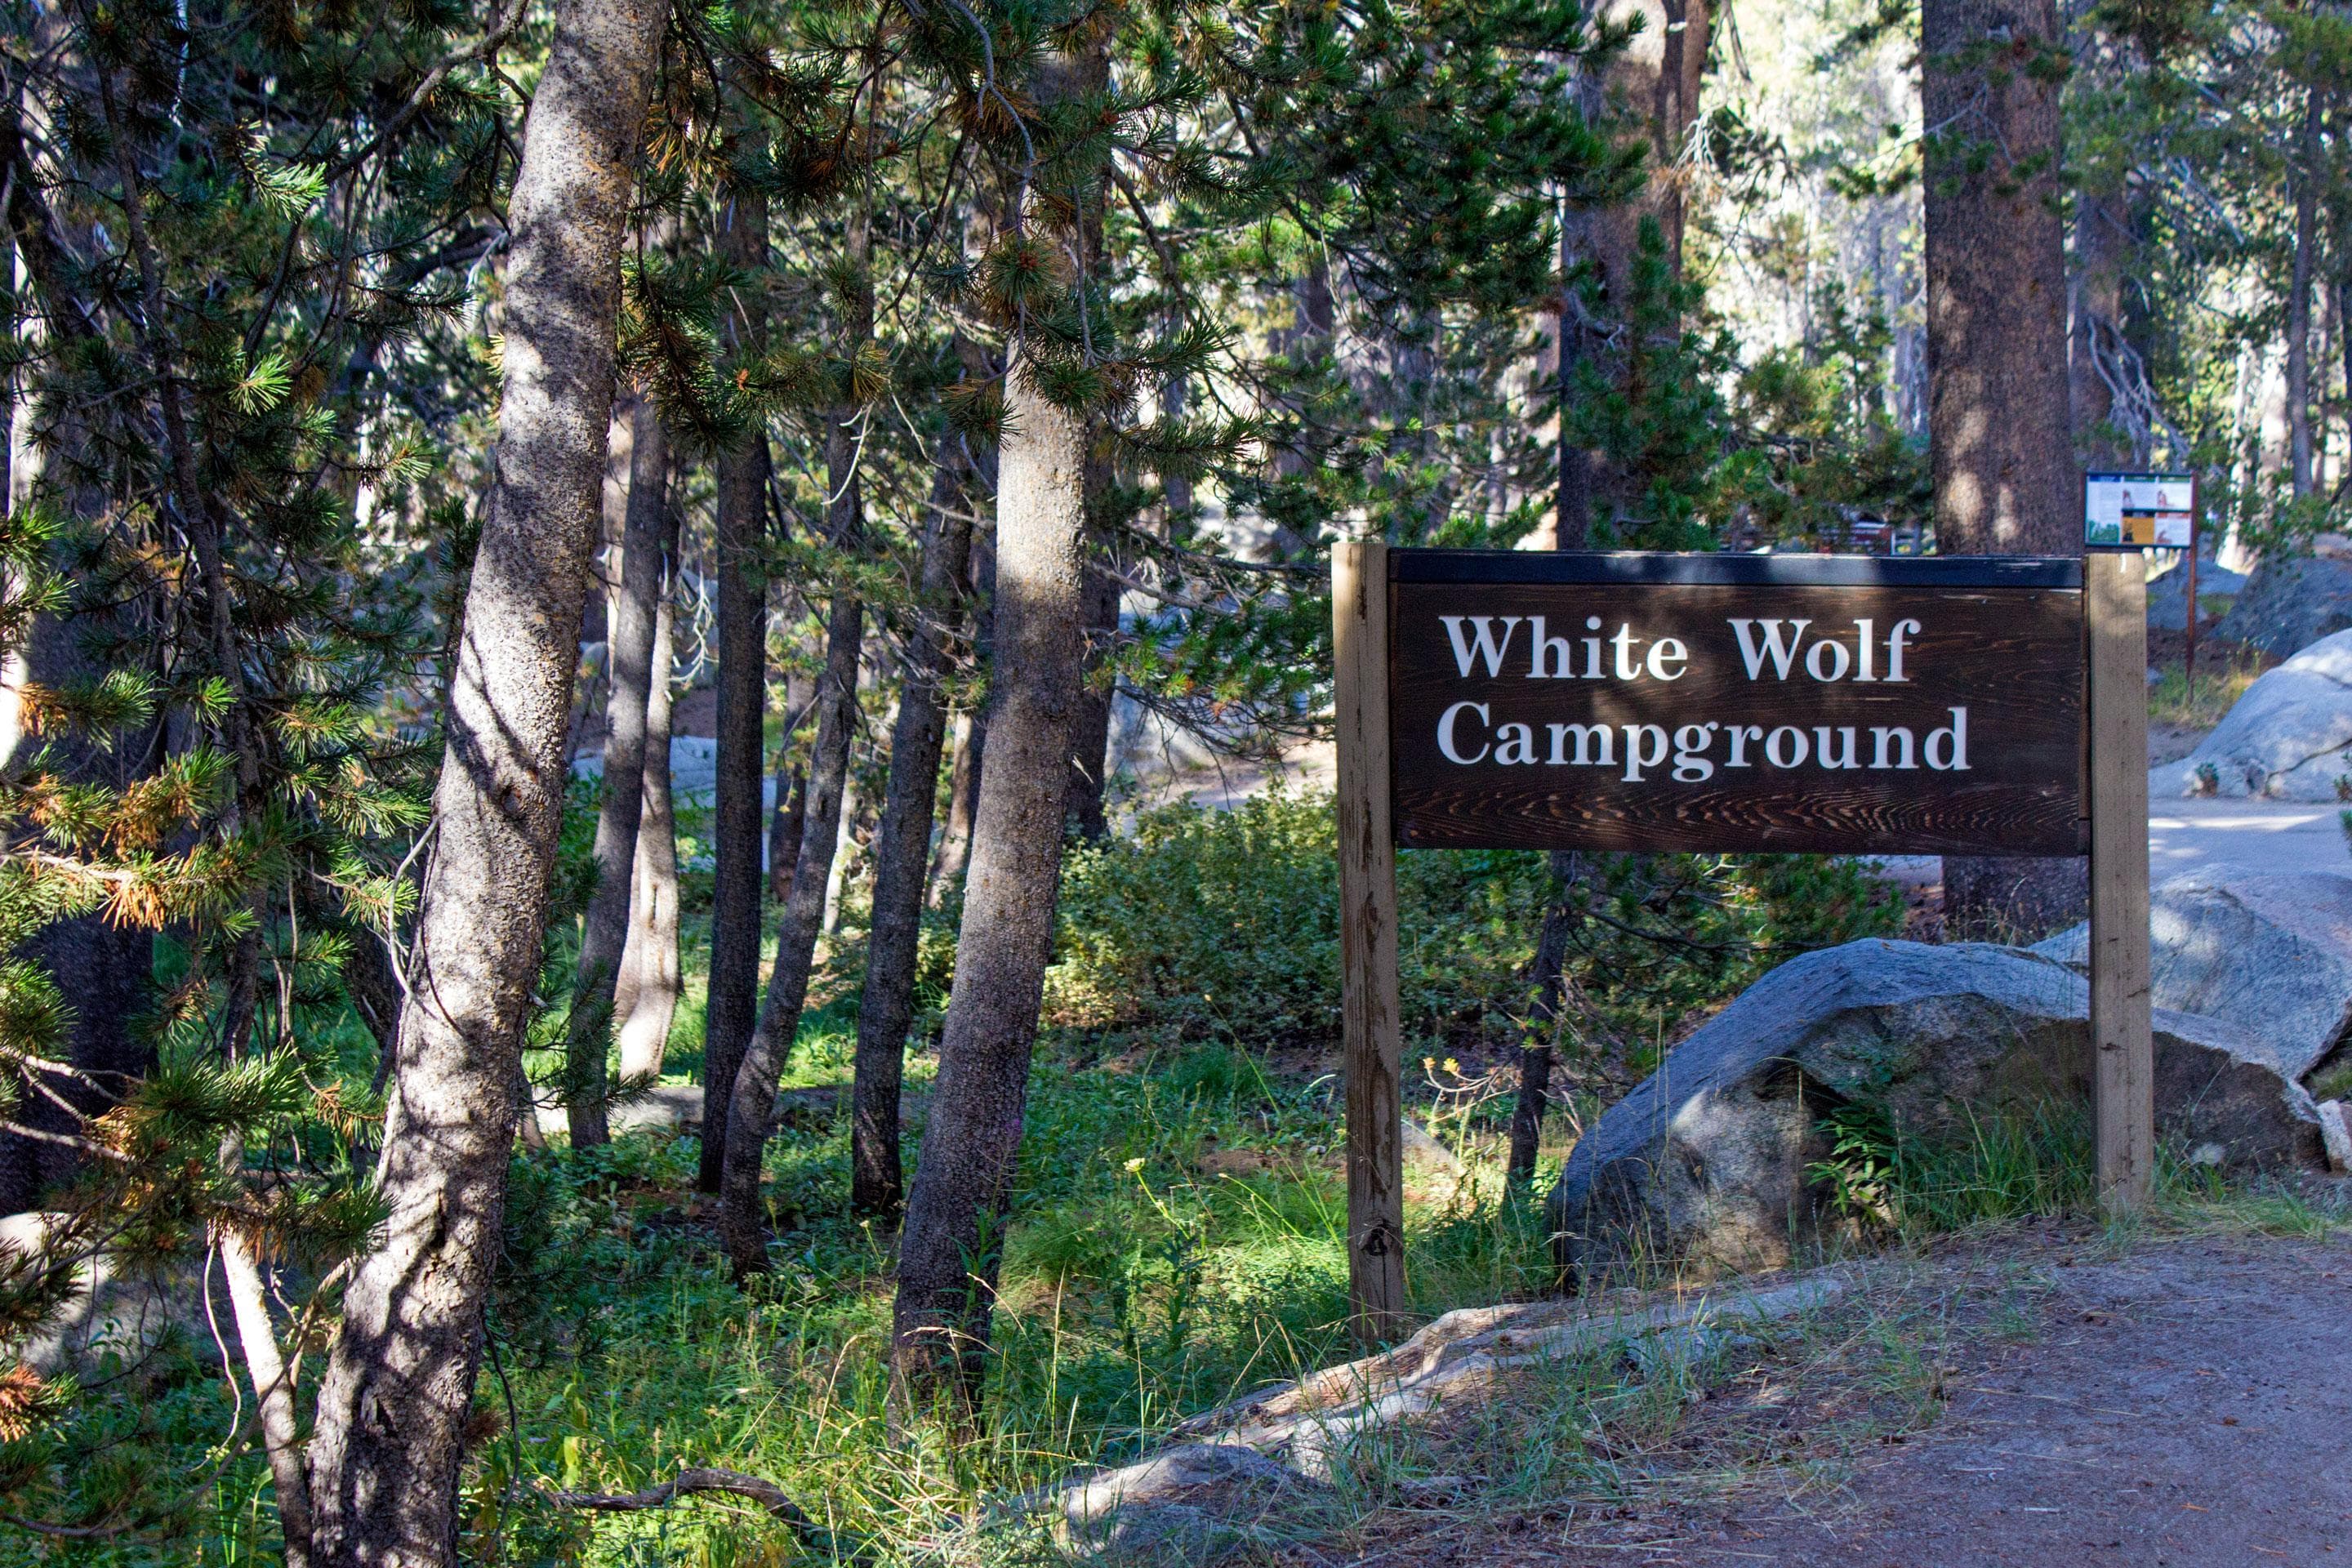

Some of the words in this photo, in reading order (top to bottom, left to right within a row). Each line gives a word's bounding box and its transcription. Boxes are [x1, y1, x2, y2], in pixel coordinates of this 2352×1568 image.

[1438, 616, 1689, 681] White
[1726, 618, 1921, 682] Wolf
[1437, 701, 1971, 782] Campground
